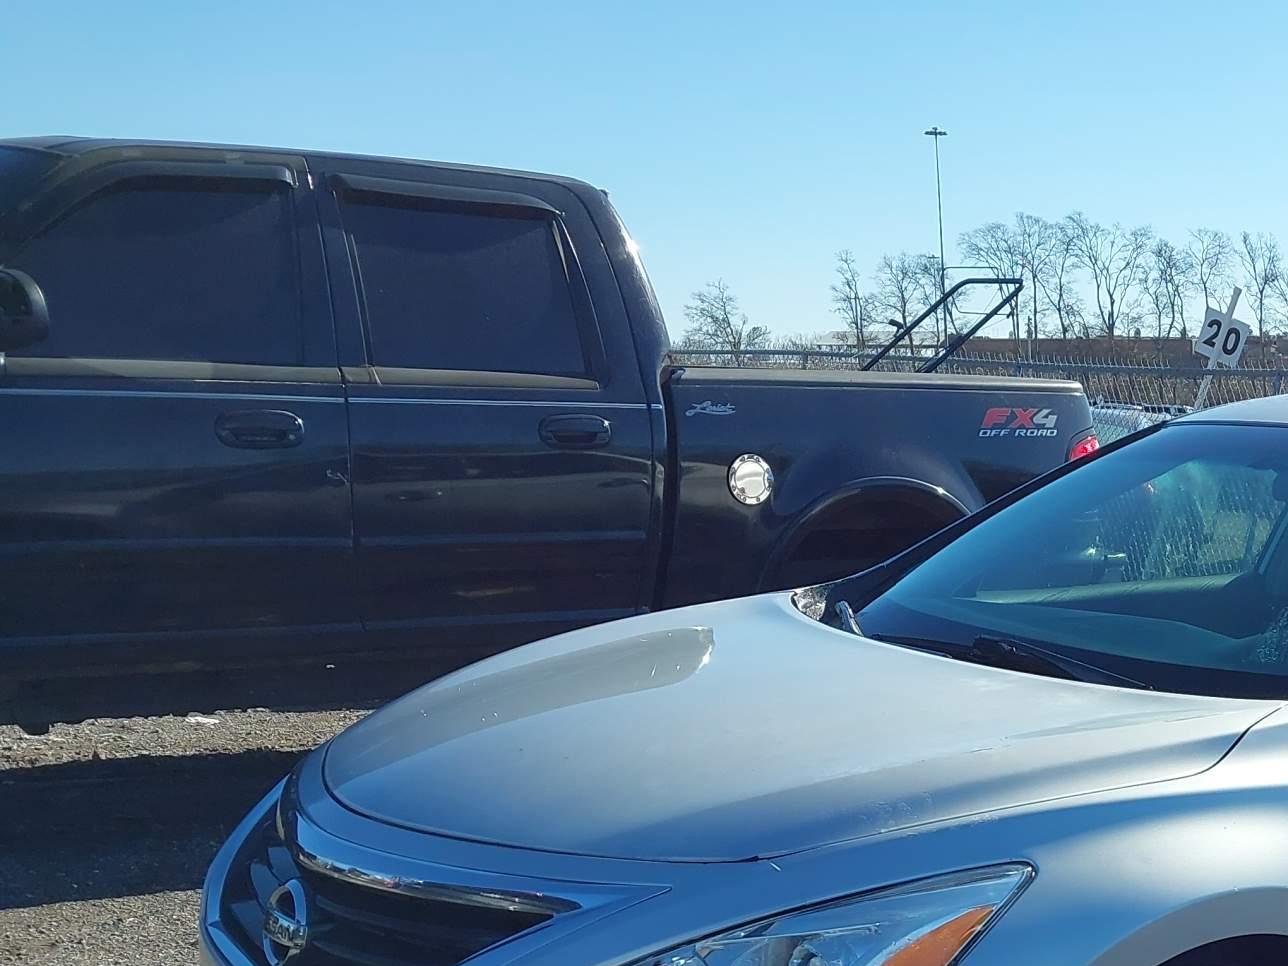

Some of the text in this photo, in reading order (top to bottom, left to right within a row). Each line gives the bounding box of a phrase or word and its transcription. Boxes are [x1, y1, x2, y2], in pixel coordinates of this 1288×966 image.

[1202, 319, 1241, 355] 20
[980, 407, 1058, 428] FX4
[978, 429, 1058, 437] OFF ROAD
